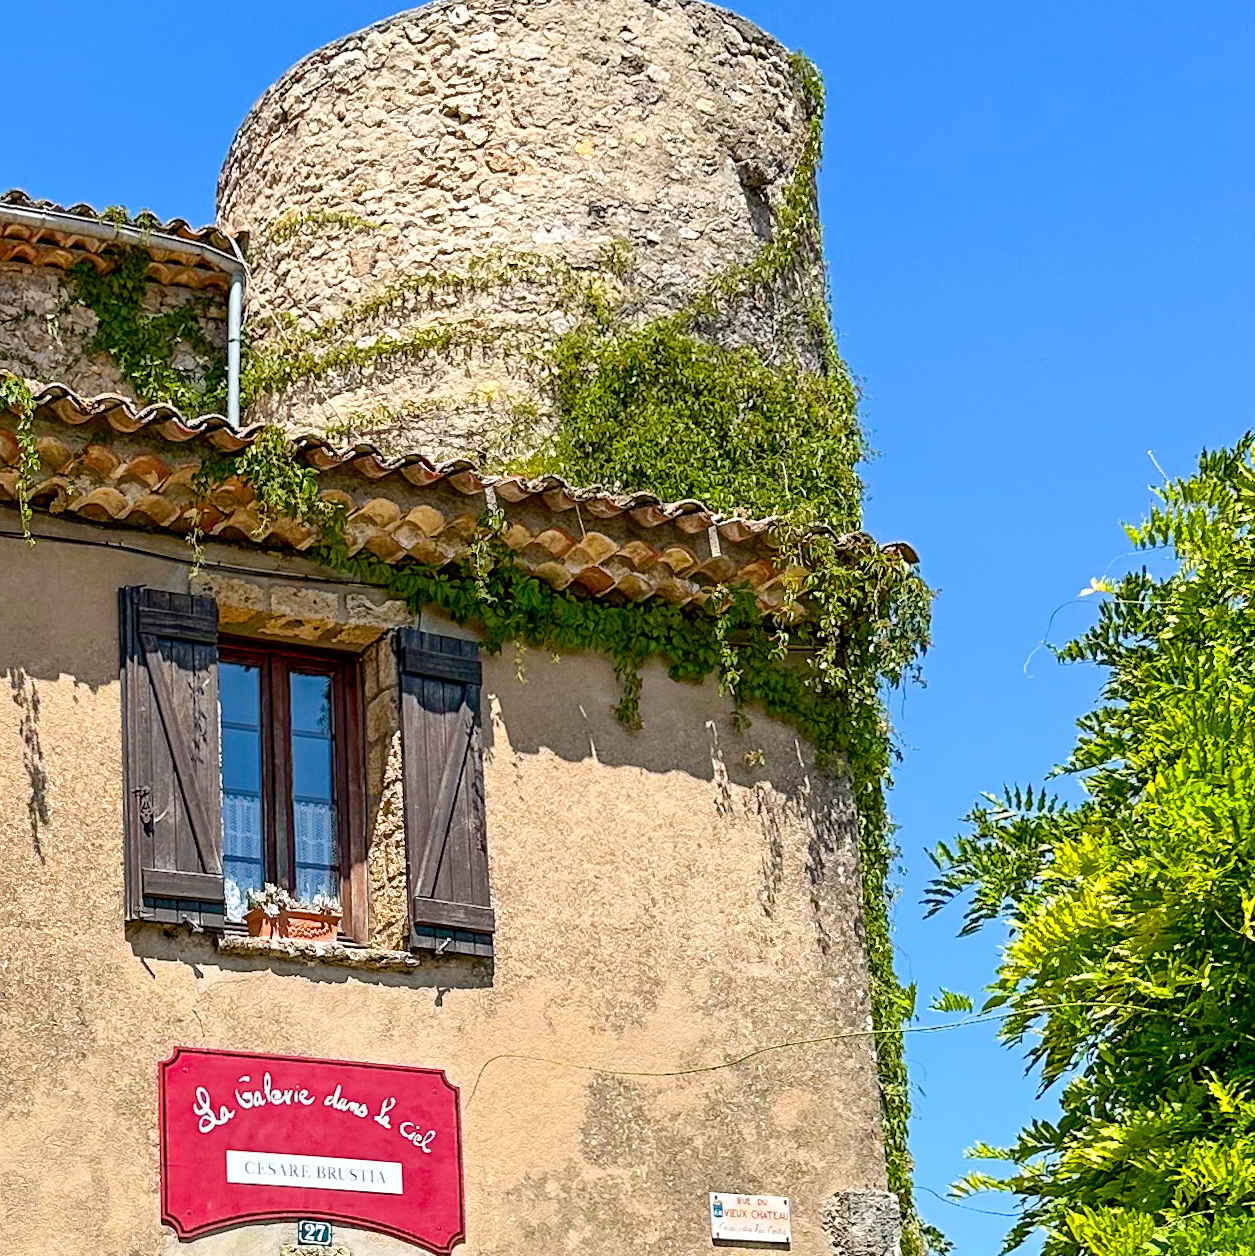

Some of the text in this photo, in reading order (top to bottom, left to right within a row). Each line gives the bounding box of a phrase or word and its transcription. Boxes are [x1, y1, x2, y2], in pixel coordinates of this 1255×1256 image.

[193, 1086, 236, 1134] La
[235, 1072, 316, 1110] Galerie
[323, 1084, 368, 1119] dans
[244, 1160, 386, 1185] CESARE BRUSTIA
[757, 1198, 767, 1206] DU
[724, 1208, 747, 1218] VIEUX
[305, 1224, 326, 1242] 27
